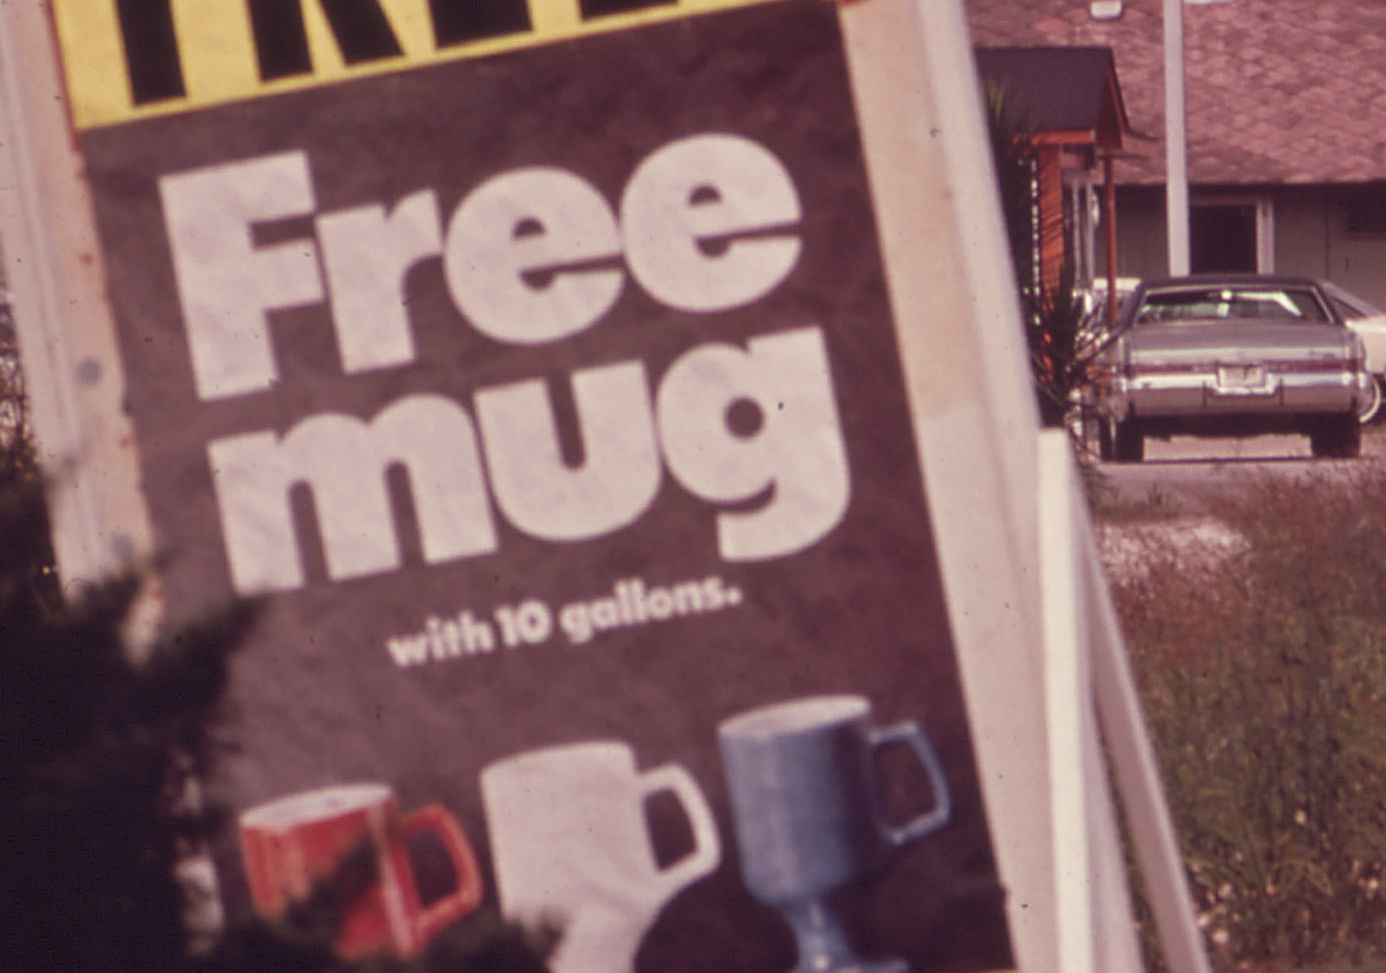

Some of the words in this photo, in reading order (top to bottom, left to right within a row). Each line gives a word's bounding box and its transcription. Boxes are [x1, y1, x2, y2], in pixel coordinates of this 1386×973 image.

[158, 130, 802, 402] Free
[206, 324, 851, 597] mug
[386, 609, 496, 668] with
[493, 598, 553, 647] 10
[558, 575, 744, 646] gallons.
